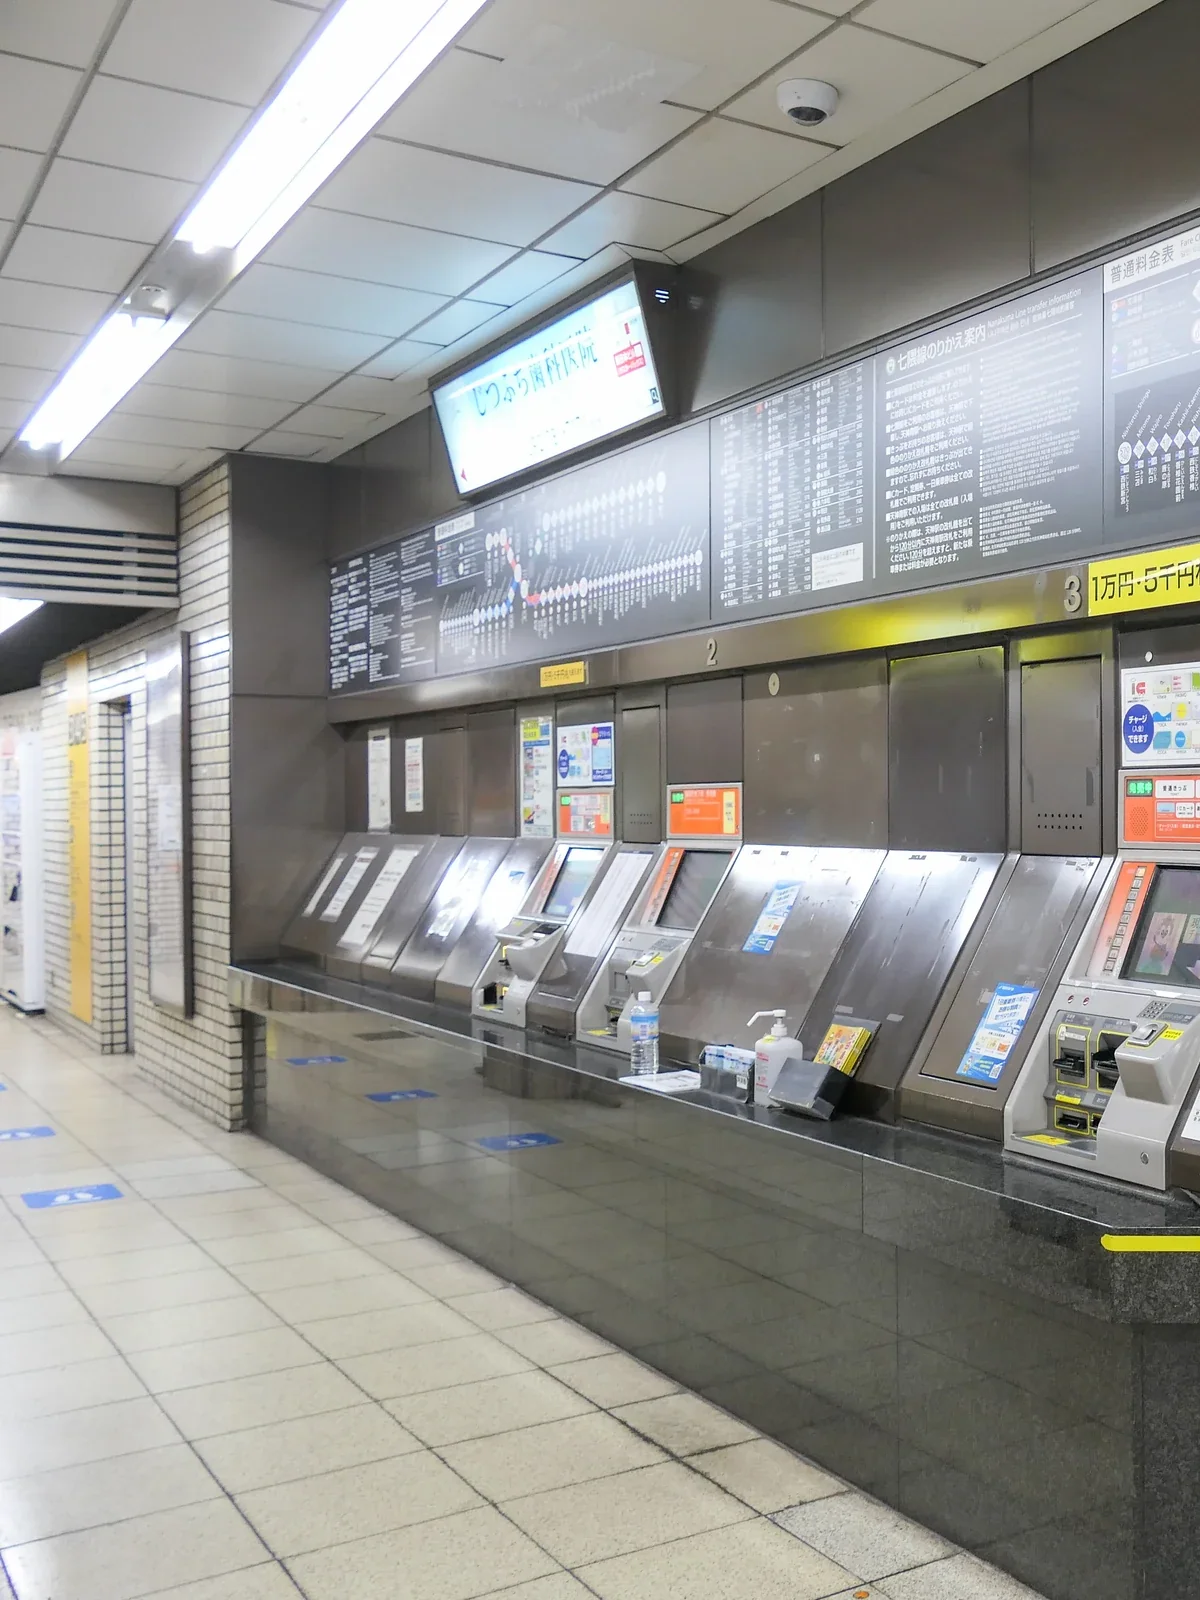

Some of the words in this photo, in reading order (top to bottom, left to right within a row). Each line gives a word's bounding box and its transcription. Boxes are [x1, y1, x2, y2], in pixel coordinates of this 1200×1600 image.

[1180, 235, 1194, 248] Fare
[1111, 244, 1174, 284] 普通料金表
[1064, 575, 1081, 612] 3
[707, 638, 717, 666] 2
[1128, 714, 1148, 724] チャージ
[1128, 734, 1148, 743] できます
